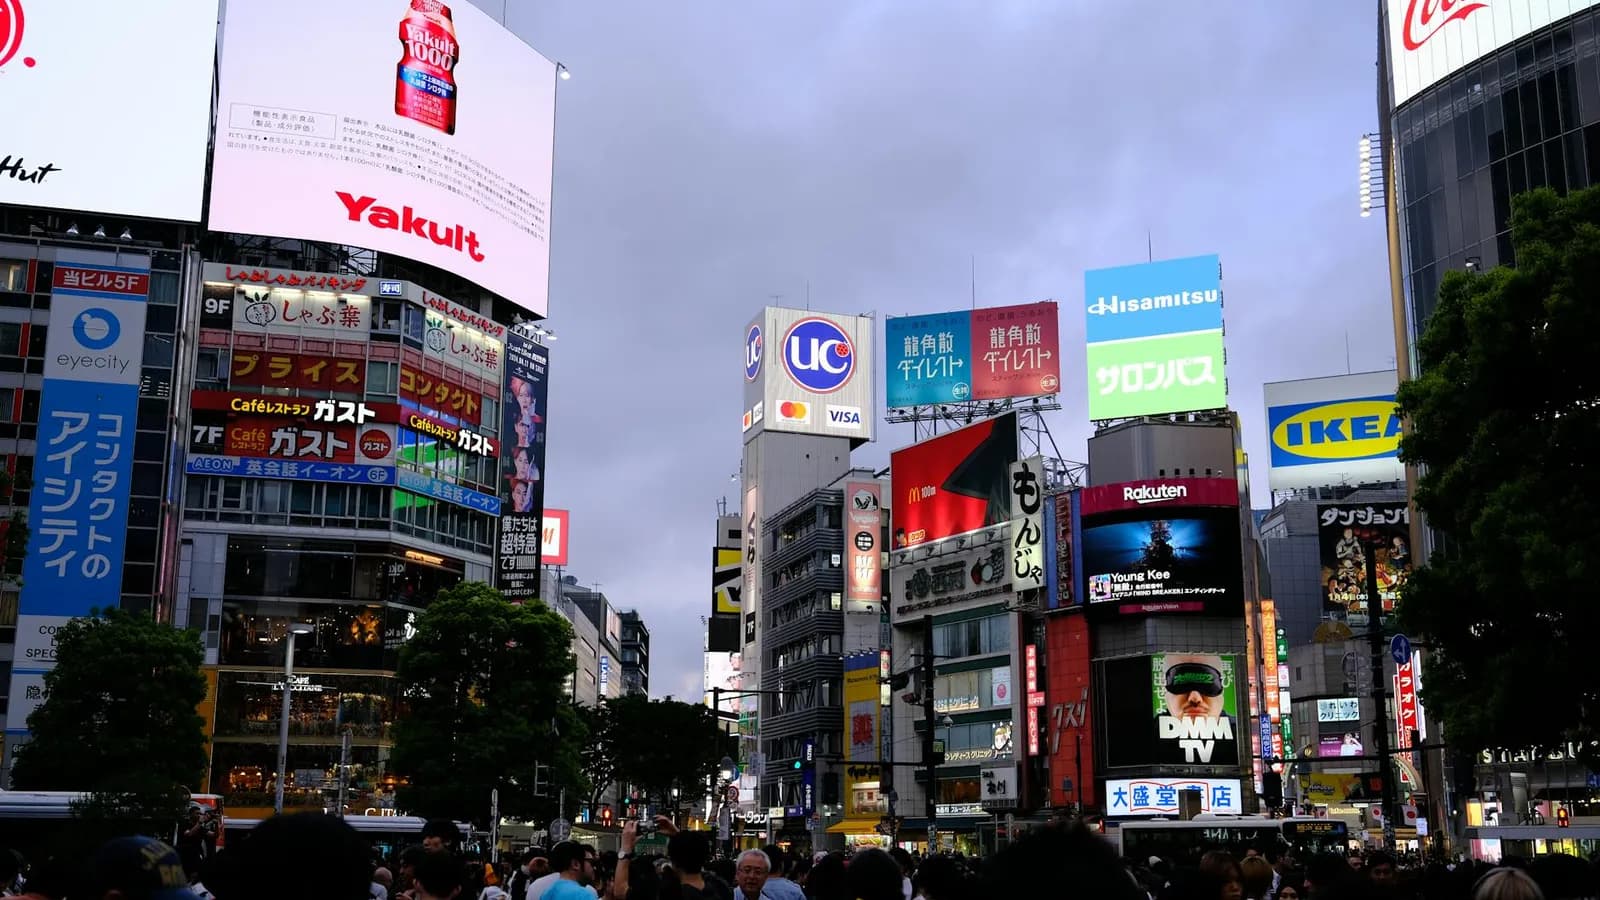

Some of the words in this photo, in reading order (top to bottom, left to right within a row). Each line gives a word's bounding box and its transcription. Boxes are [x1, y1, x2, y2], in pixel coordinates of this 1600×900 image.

[405, 23, 455, 57] Yakult
[405, 39, 453, 71] 1000
[0, 155, 62, 184] Hut
[335, 190, 485, 263] Yakult
[63, 270, 140, 290] 当ビル5F
[226, 266, 367, 291] しゃぶしゃぶバイキング
[381, 283, 400, 295] 寿司
[205, 298, 230, 315] 9F
[282, 300, 361, 328] しゃぶ葉
[423, 291, 504, 337] しゃぶしゃぶバイキング
[1087, 288, 1218, 316] Hisamitsu
[904, 331, 954, 358] 龍角散
[990, 323, 1042, 349] 龍角散
[57, 353, 130, 374] eyecity
[451, 332, 498, 369] しゃぶ葉
[983, 347, 1052, 373] ダイレクト
[233, 354, 361, 384] プライス
[897, 355, 964, 381] ダイレクト
[1096, 355, 1217, 396] サロンパス
[401, 366, 478, 415] コンタクト
[313, 399, 376, 424] ガスト
[829, 410, 860, 424] VISA
[193, 425, 224, 444] 7F
[231, 427, 266, 442] Café
[232, 442, 266, 451] レストラン
[269, 427, 348, 458] ガスト
[363, 442, 389, 452] ガスト
[458, 429, 494, 456] ガスト
[194, 457, 233, 470] AEON
[39, 410, 90, 577] アイシティ
[81, 413, 123, 579] コンタクトの
[1123, 484, 1187, 503] Rakuten
[502, 515, 538, 532] 僕たちは
[1013, 462, 1043, 584] もんじゃ
[500, 533, 537, 555] 超特急
[1110, 572, 1145, 583] Young
[1147, 570, 1171, 580] Kee
[1152, 657, 1168, 715] 脱出せよ
[1221, 660, 1234, 688] 再び
[1320, 711, 1359, 720] クリニック
[1329, 701, 1358, 710] れいわ
[1158, 715, 1234, 740] DMM
[1179, 740, 1215, 763] TV
[1113, 785, 1232, 808] 大盛堂店
